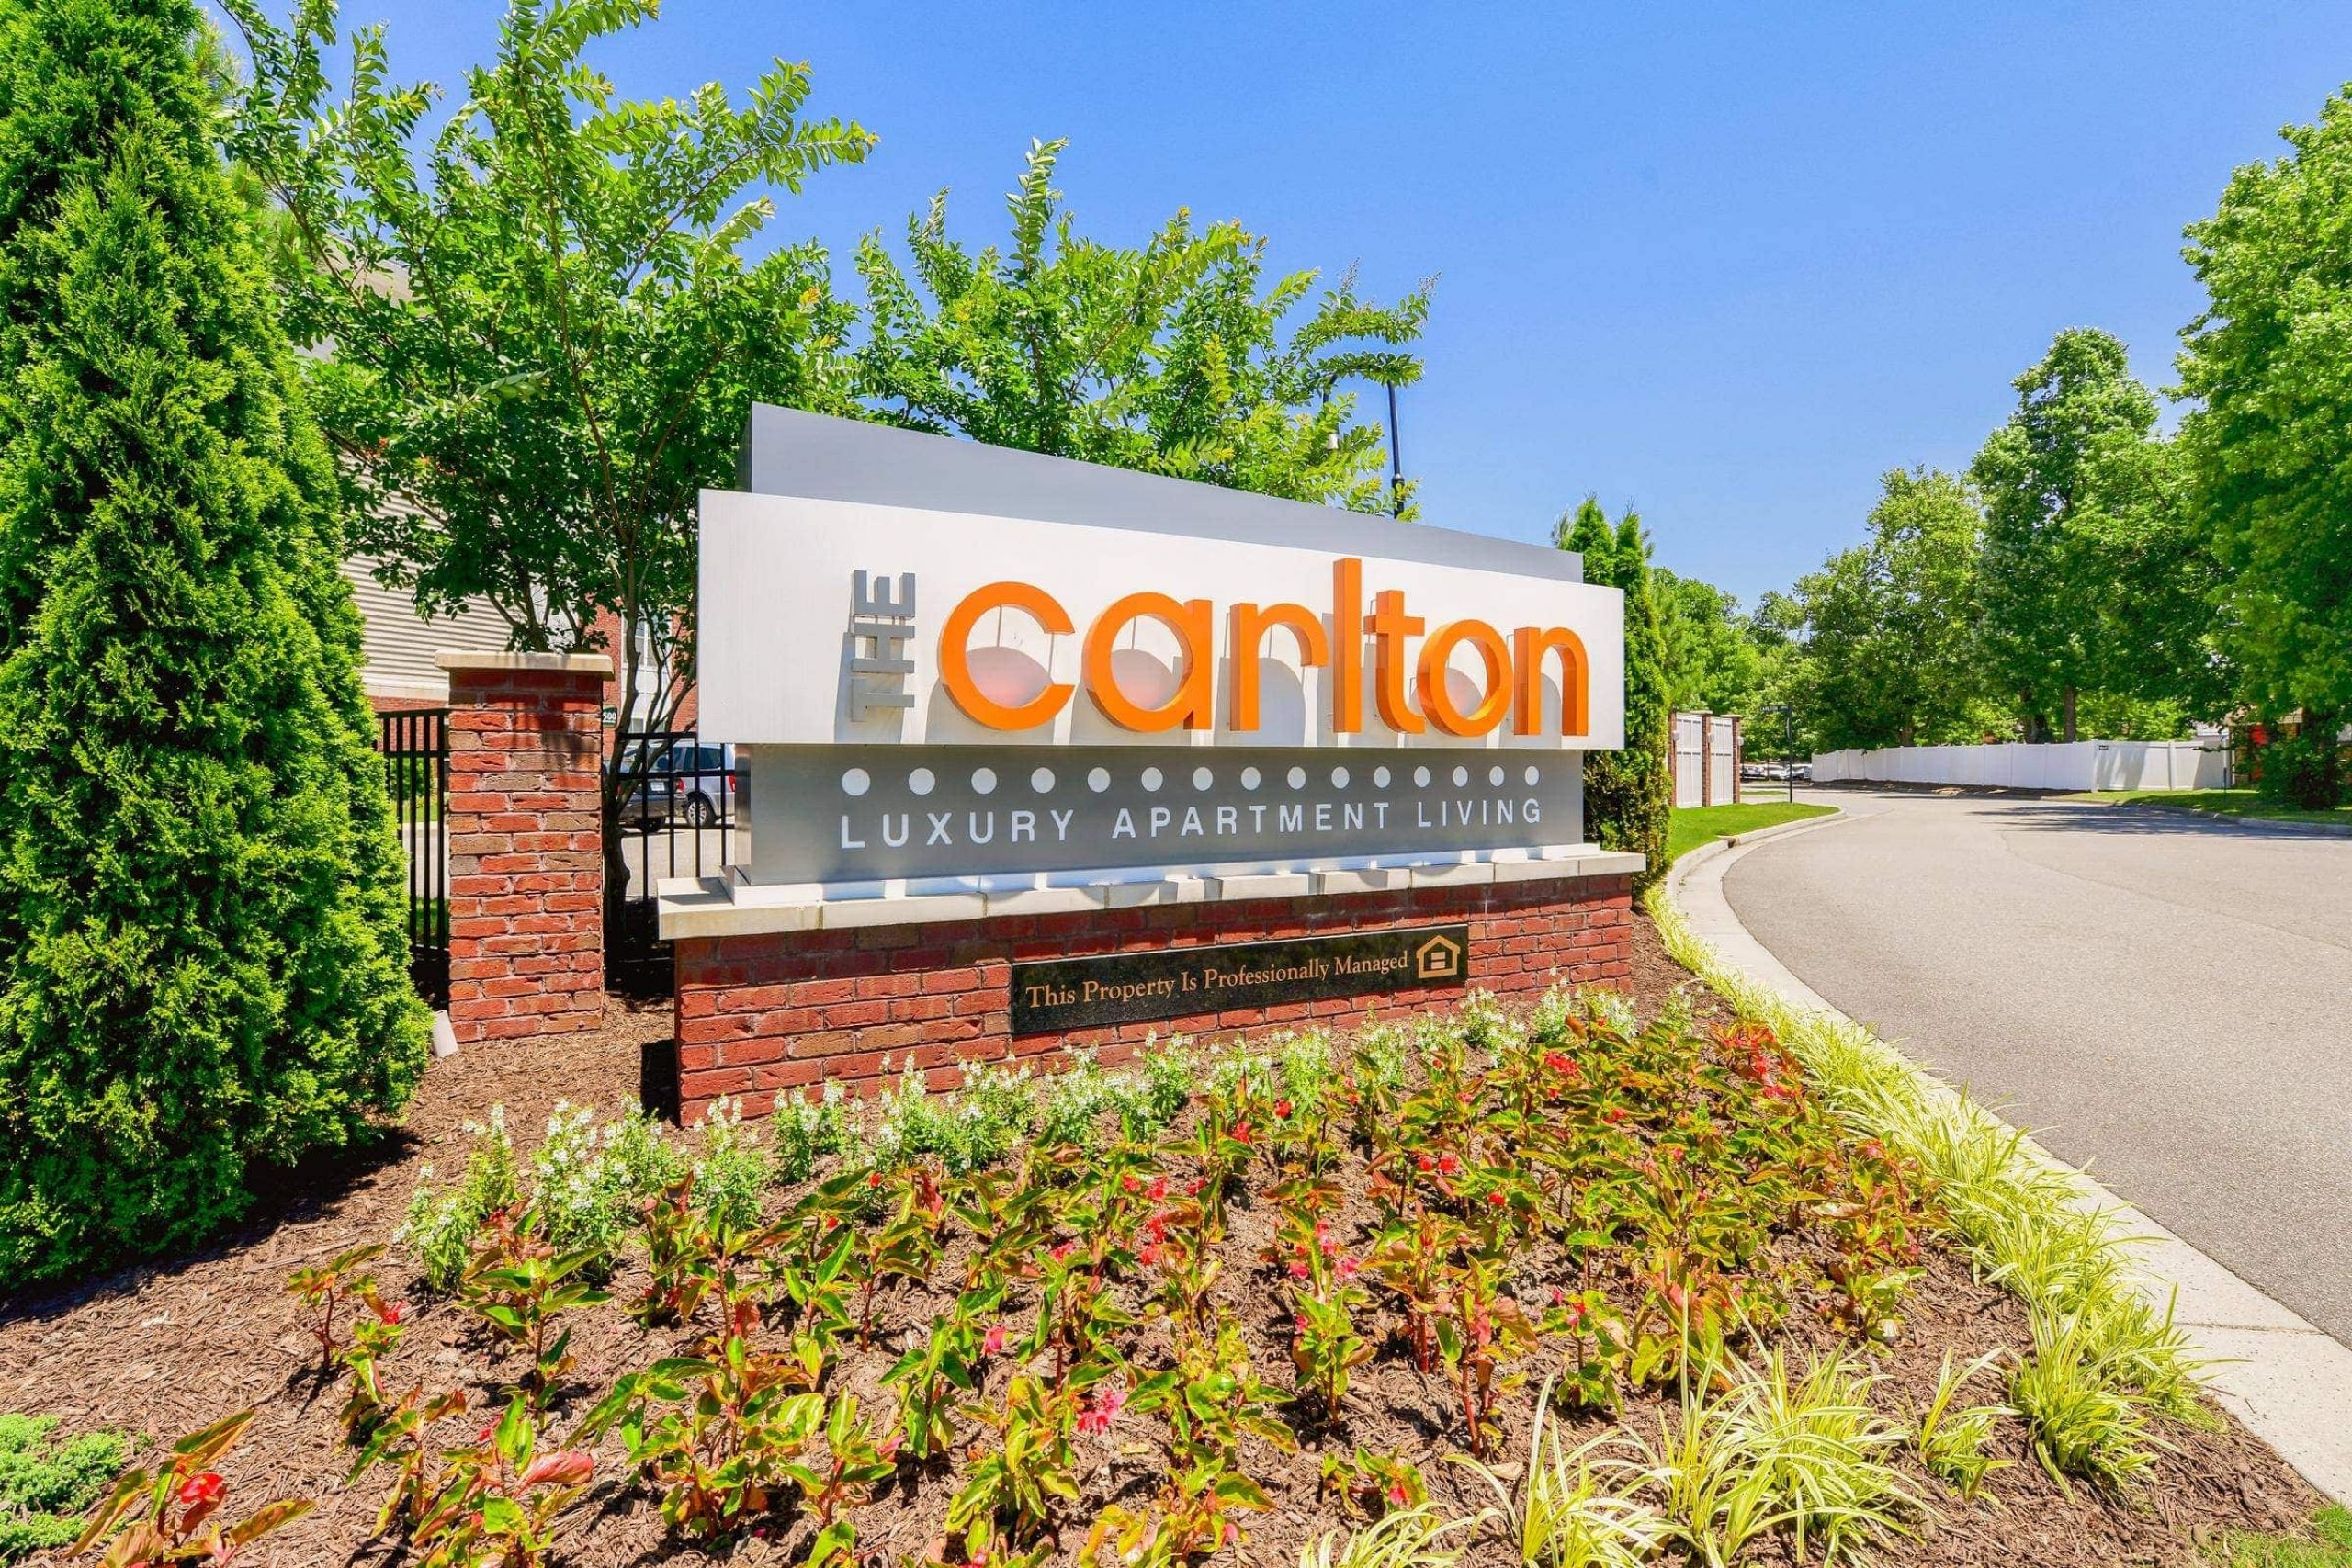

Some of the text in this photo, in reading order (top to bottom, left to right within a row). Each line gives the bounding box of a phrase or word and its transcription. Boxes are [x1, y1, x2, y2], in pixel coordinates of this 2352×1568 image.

[851, 570, 916, 723] THE
[937, 558, 1589, 737] carlton
[841, 798, 1541, 849] LUXURY APARTMENT LIVING
[1025, 950, 1408, 1009] This Property Is Professionally Managed
